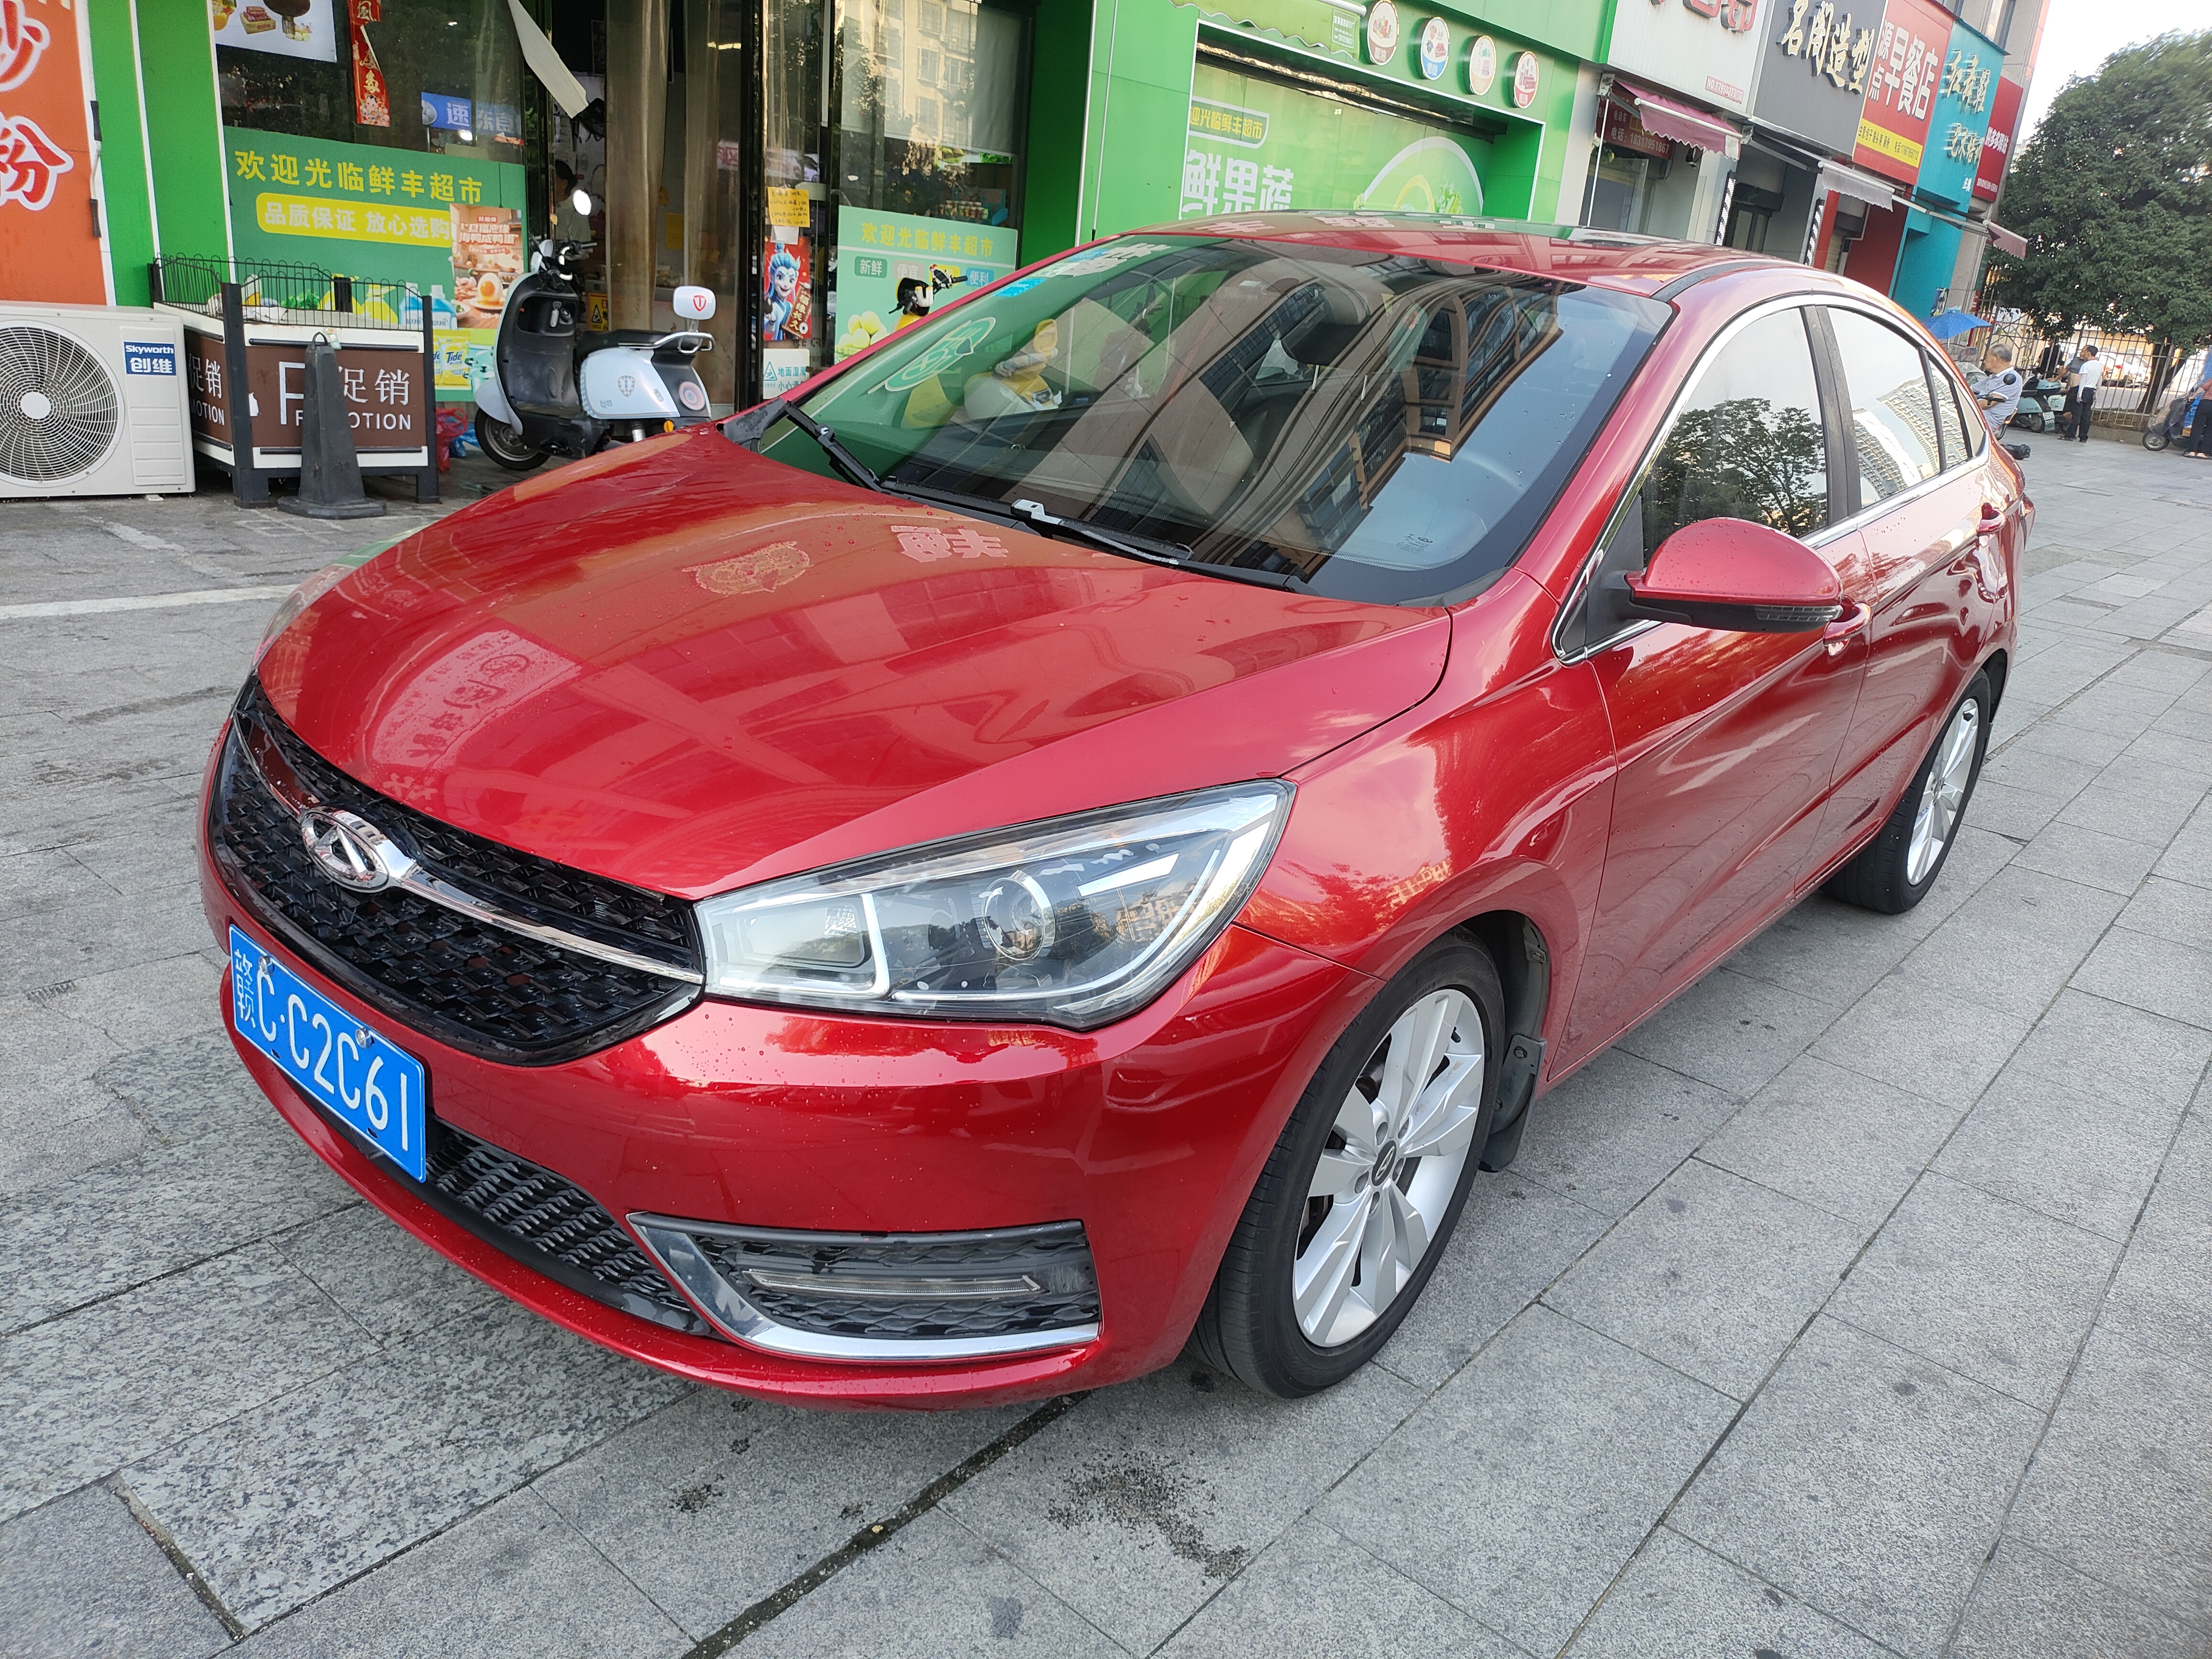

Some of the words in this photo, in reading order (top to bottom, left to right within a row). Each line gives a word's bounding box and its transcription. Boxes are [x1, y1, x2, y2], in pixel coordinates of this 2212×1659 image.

[1885, 26, 1938, 120] 早餐店
[447, 102, 520, 133] 速冻食
[235, 150, 482, 205] 欢迎光临鲜丰超市
[1182, 149, 1294, 215] 鲜果蔬
[265, 201, 356, 232] 品质保证
[366, 211, 450, 241] 放心选购
[861, 222, 993, 257] 欢迎光临鲜丰超市
[860, 259, 883, 276] 新鲜
[969, 271, 989, 285] 便利
[125, 345, 174, 354] Skyworth
[130, 357, 173, 374] 创维
[446, 351, 463, 364] Tide
[189, 353, 222, 399] 促销
[338, 365, 410, 406] 促销
[778, 366, 806, 377] 地面湿滑
